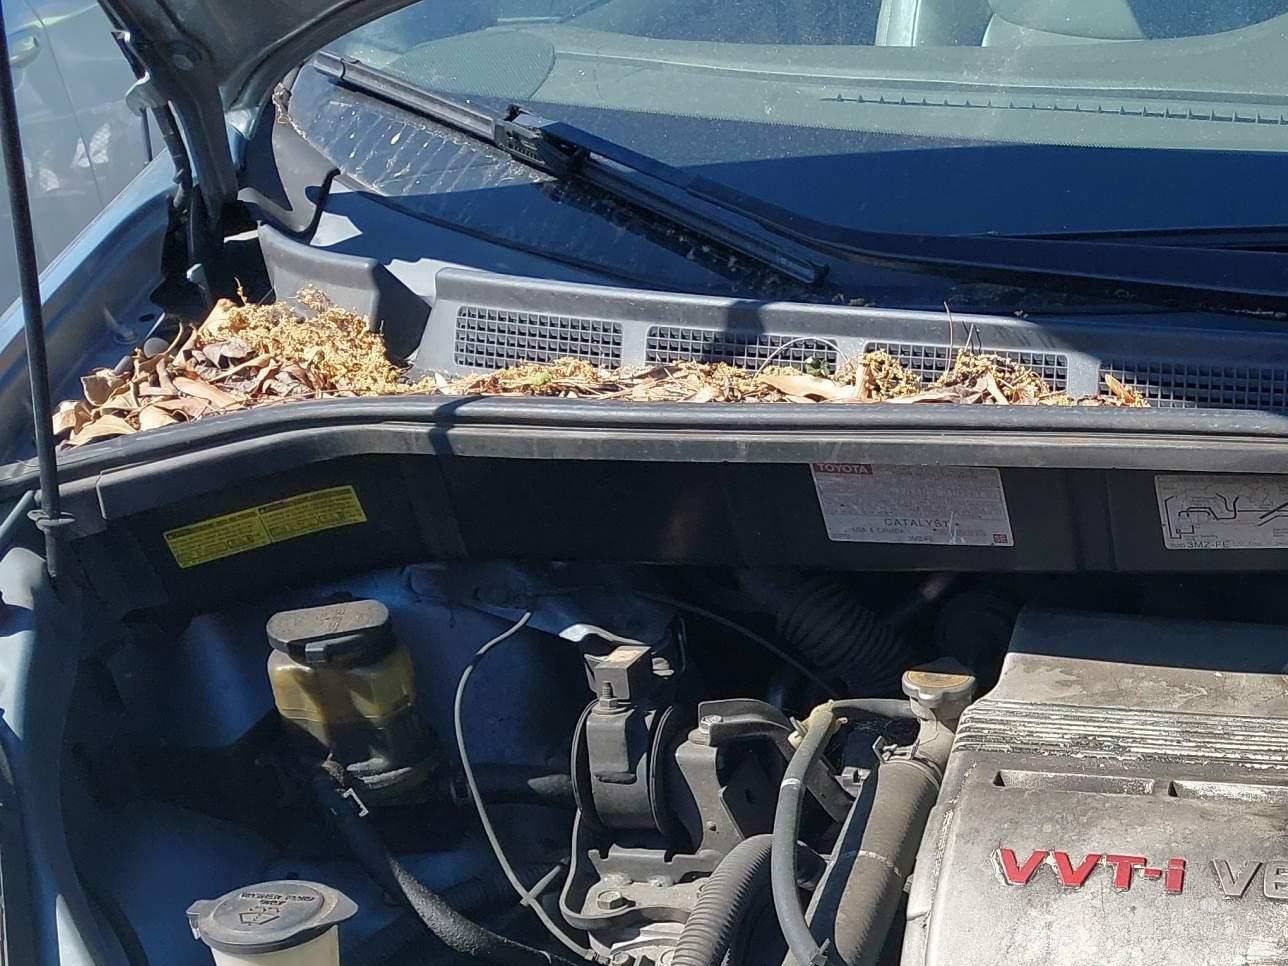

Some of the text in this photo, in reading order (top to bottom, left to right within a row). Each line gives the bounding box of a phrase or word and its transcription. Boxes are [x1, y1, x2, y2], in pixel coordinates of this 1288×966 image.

[818, 463, 868, 474] TOYOTA
[884, 518, 950, 528] CATALYST
[993, 848, 1185, 895] VVT-i
